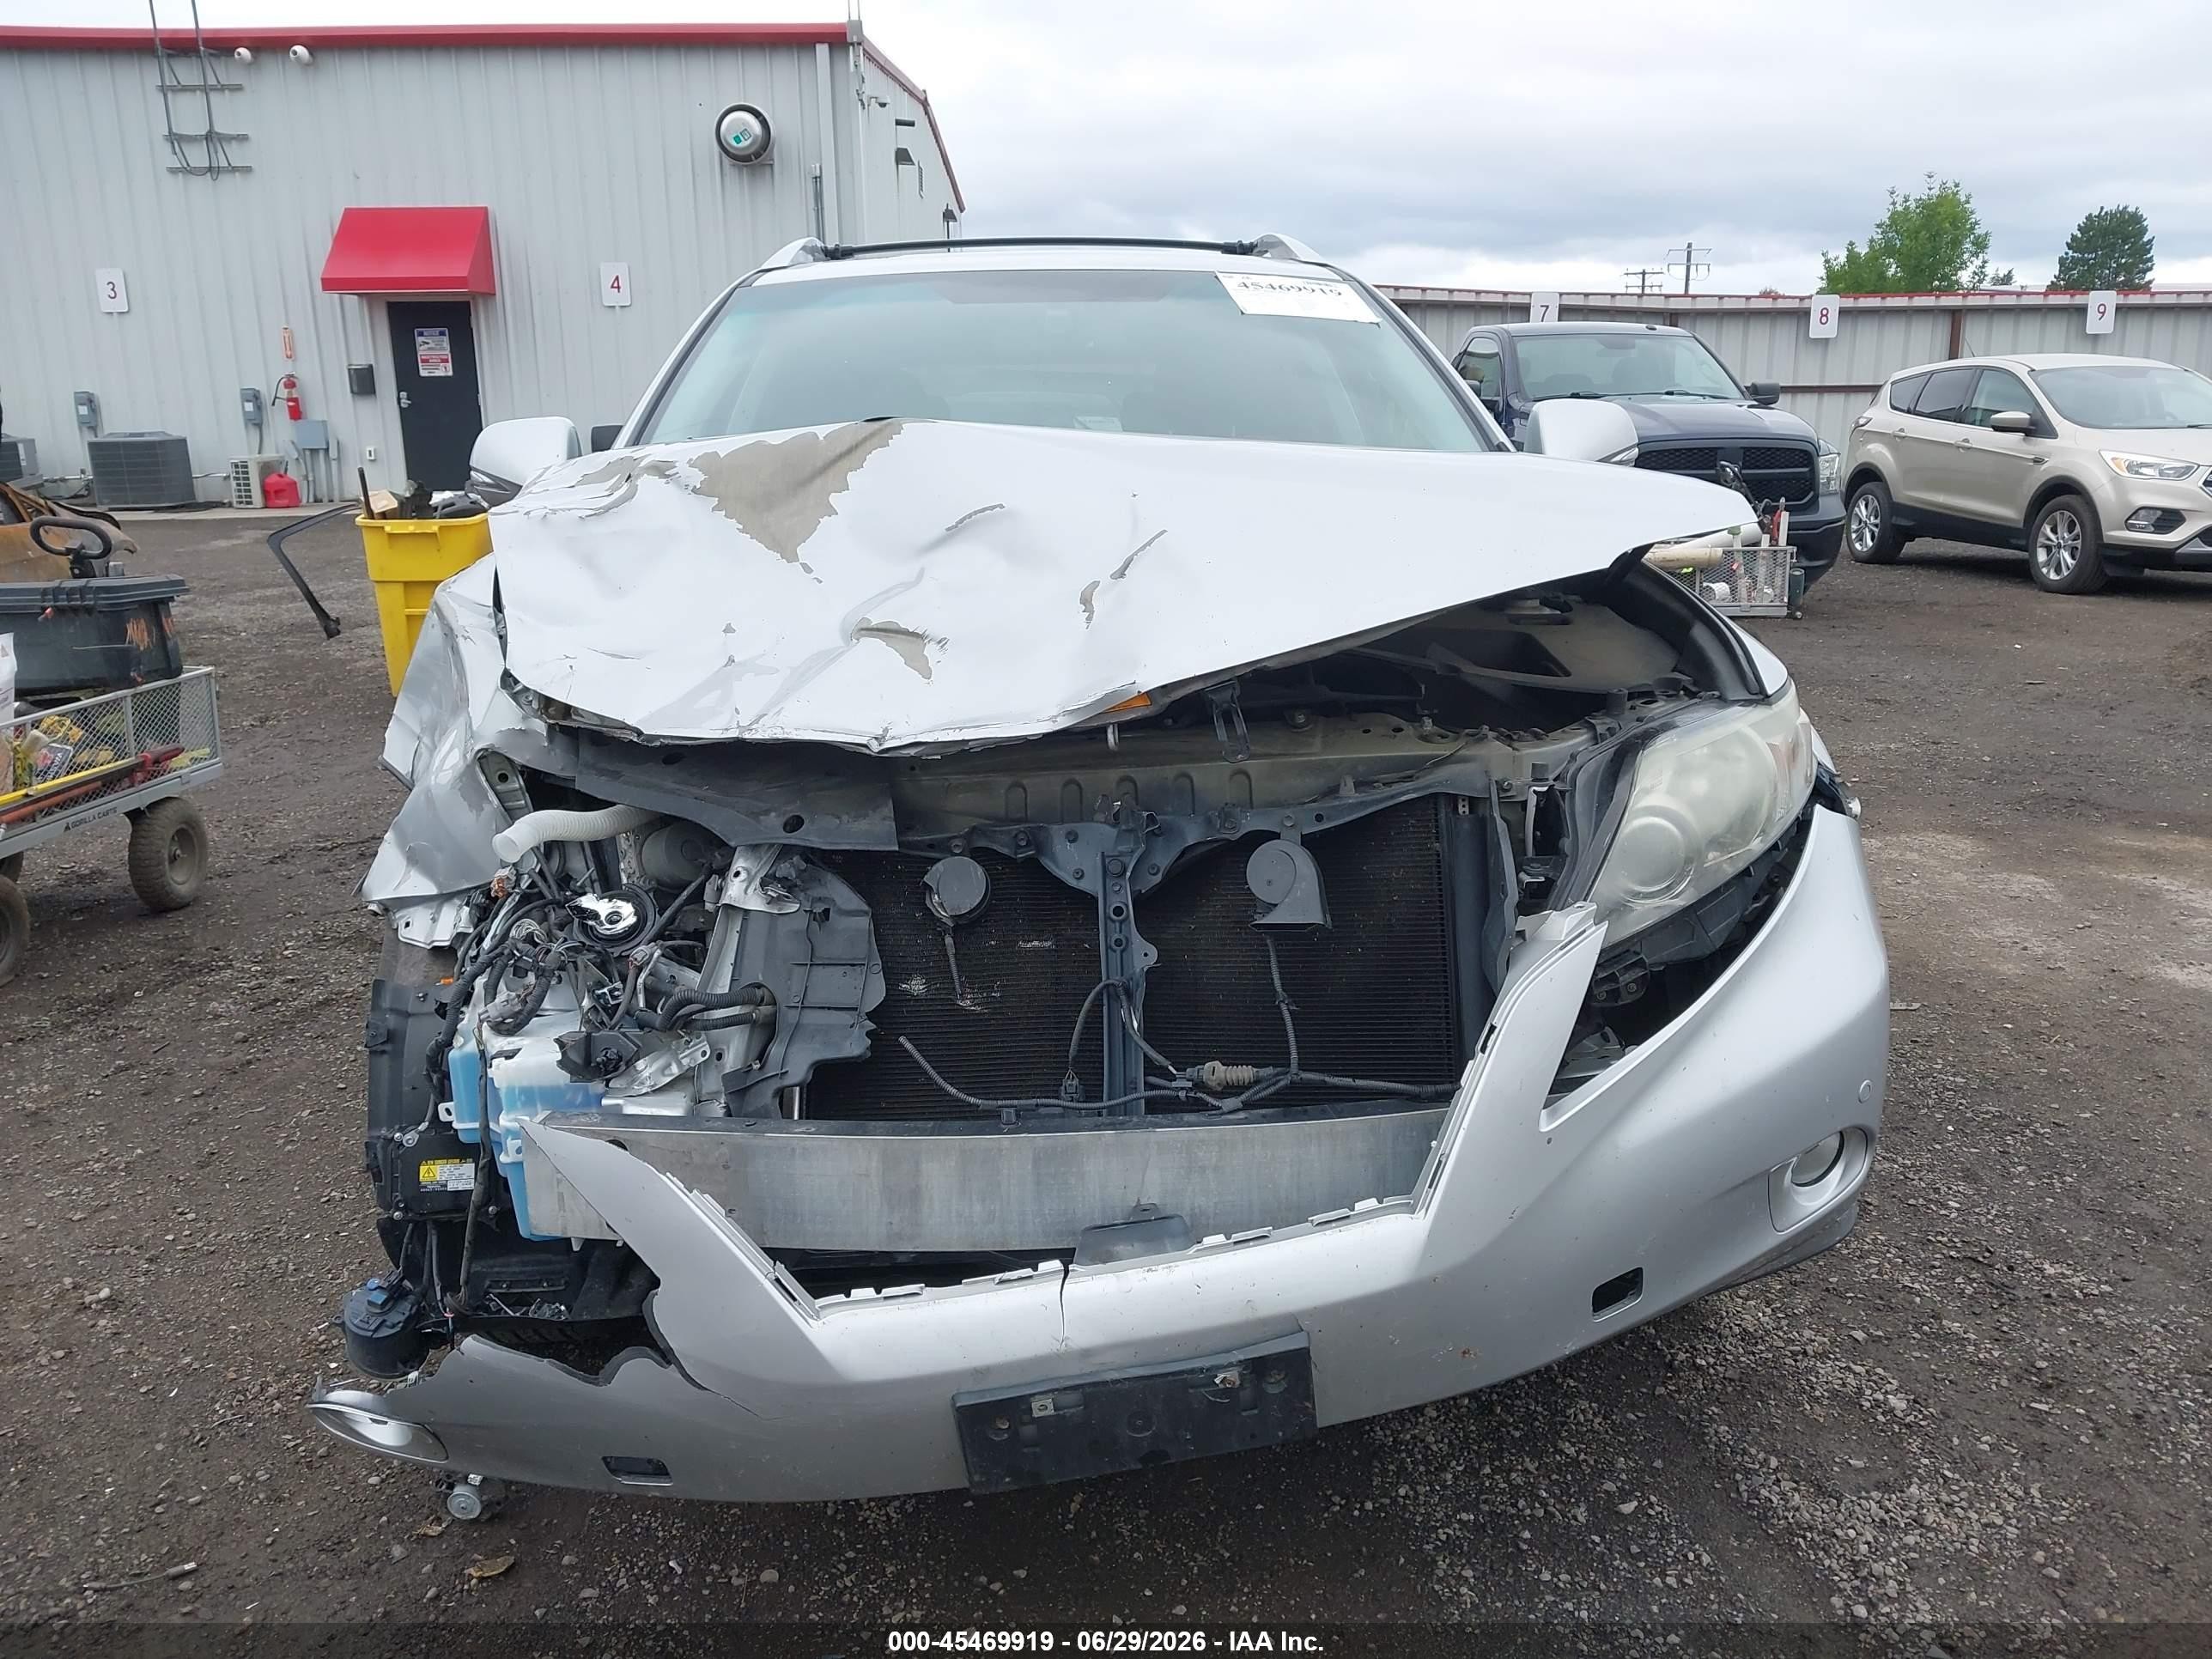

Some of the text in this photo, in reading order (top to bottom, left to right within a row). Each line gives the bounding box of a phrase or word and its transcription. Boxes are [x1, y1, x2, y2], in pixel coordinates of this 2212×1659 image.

[106, 281, 118, 300] 3
[610, 274, 622, 294] 4
[1540, 304, 1550, 322] 7
[1819, 307, 1829, 325] 8
[2097, 302, 2107, 321] 9
